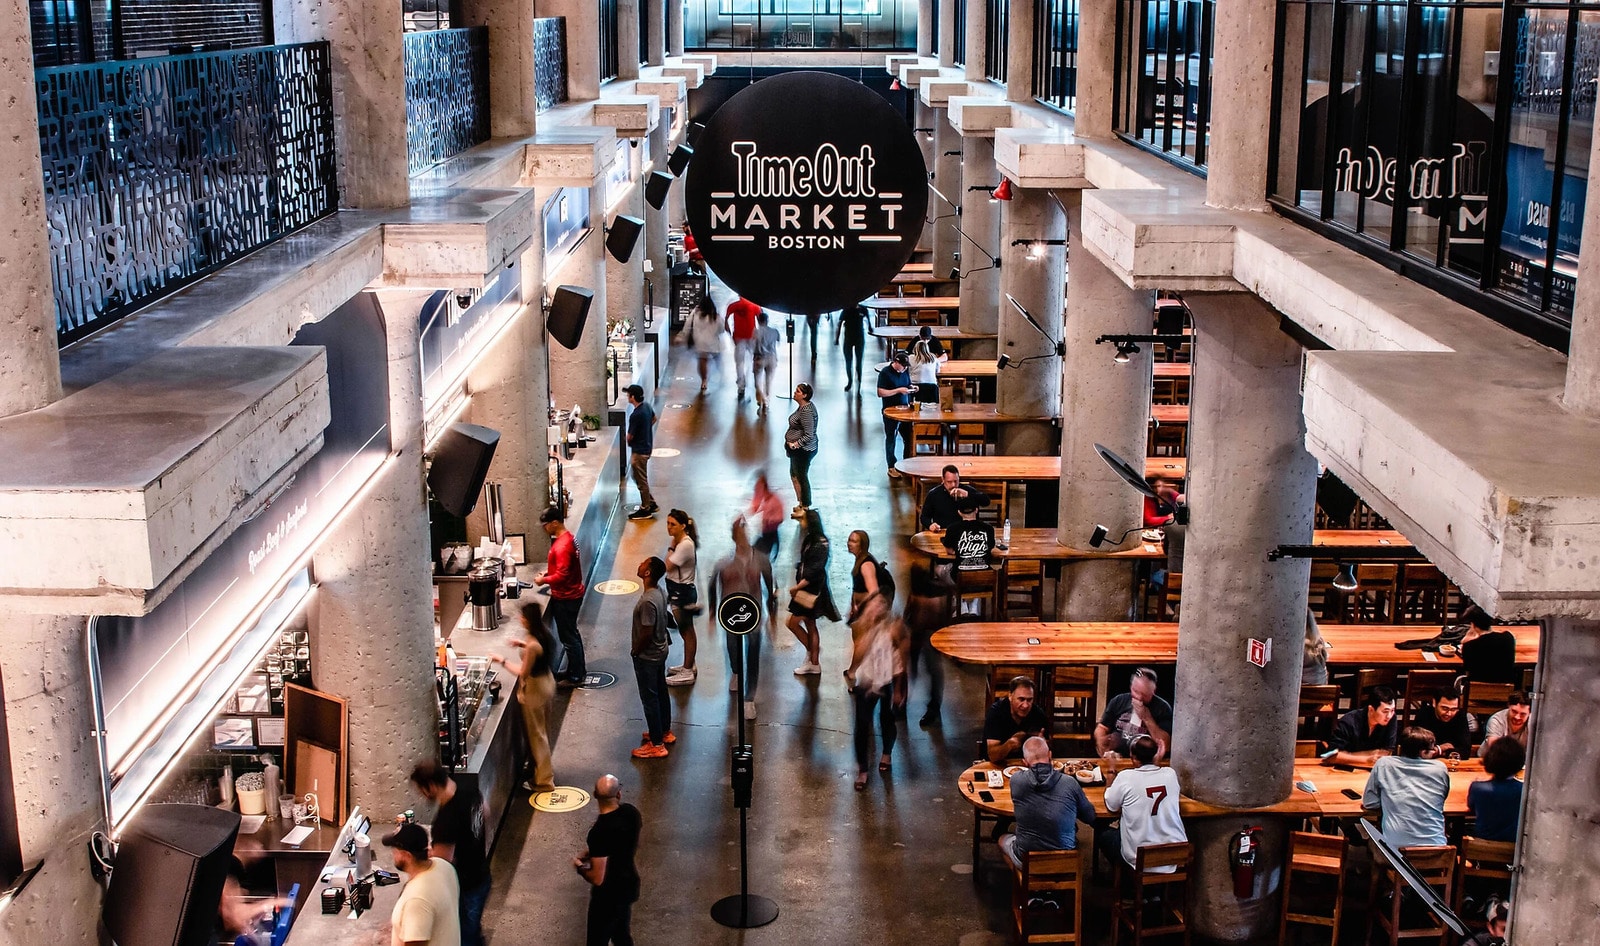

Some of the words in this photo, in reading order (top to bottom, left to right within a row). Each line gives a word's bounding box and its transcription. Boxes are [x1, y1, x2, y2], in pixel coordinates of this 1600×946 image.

[731, 141, 813, 197] Time
[814, 142, 876, 197] Out
[711, 204, 903, 230] MARKET
[768, 235, 845, 249] BOSTON
[959, 531, 985, 543] Aces
[959, 540, 988, 556] High
[1145, 785, 1168, 817] 7
